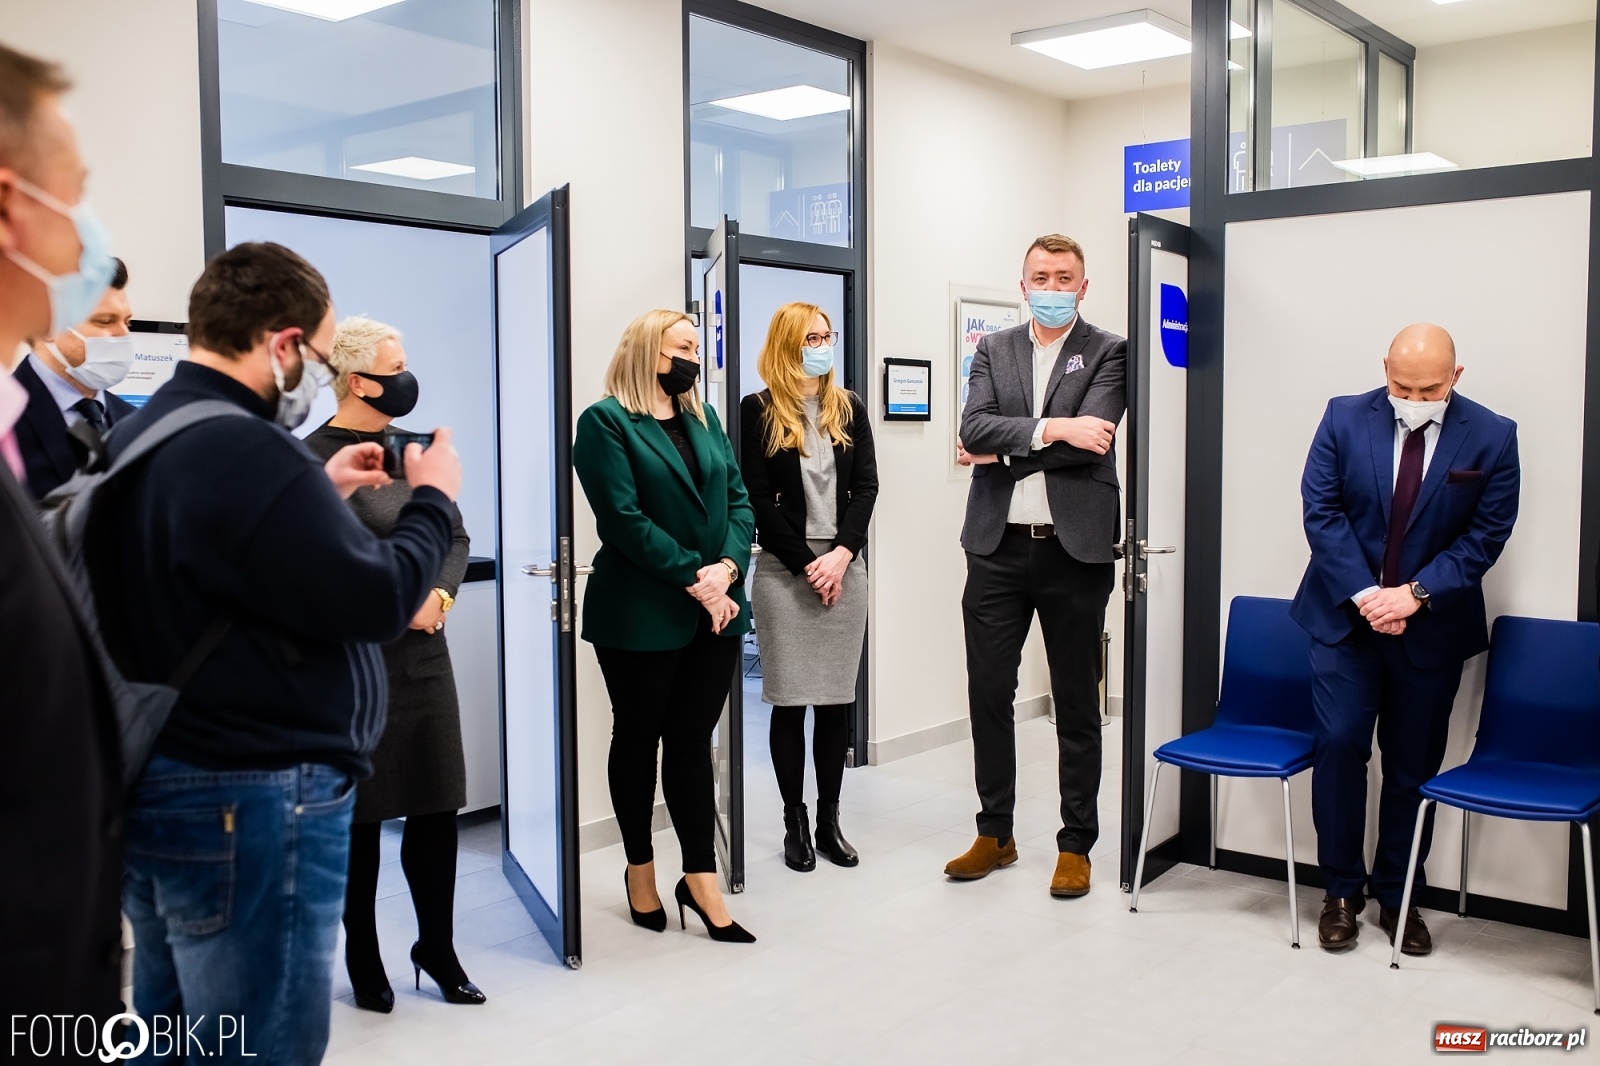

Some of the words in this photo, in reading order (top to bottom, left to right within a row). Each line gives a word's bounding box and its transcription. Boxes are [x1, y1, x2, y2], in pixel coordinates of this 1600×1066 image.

[1133, 159, 1181, 174] Toalety
[1133, 179, 1153, 193] dla
[966, 318, 985, 333] JAK
[135, 353, 173, 361] Matuszek
